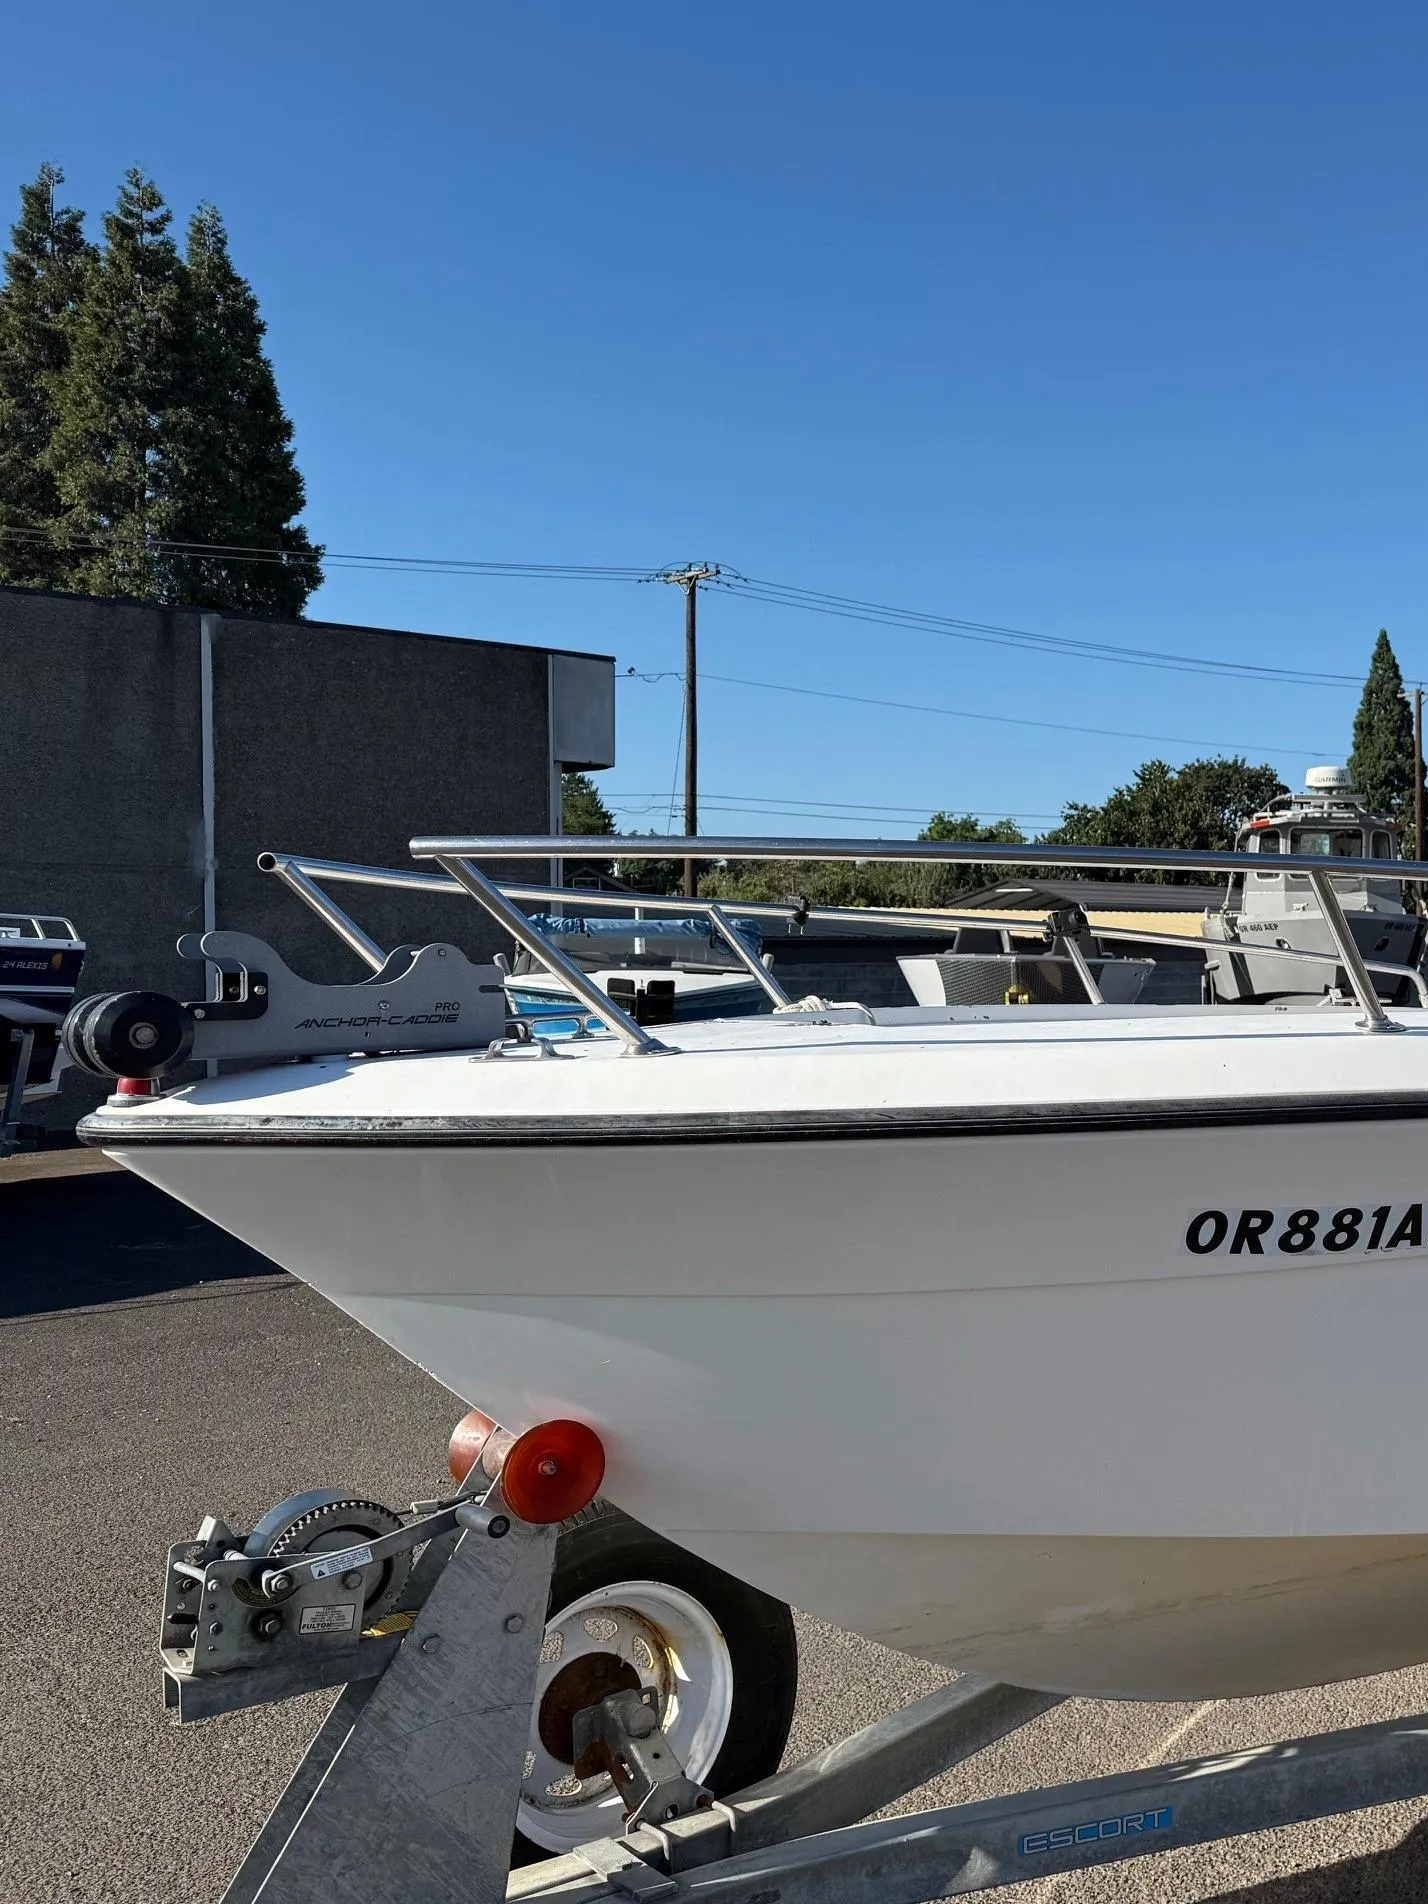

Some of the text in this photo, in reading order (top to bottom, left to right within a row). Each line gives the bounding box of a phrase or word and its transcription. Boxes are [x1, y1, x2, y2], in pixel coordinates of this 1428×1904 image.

[1314, 776, 1346, 784] GARMIN
[16, 961, 48, 970] ALEXIS
[434, 1001, 461, 1012] PRO
[294, 1013, 460, 1030] ANCHOR-CADDIE
[301, 1622, 332, 1631] FULTON
[1023, 1808, 1167, 1856] ESCORT
